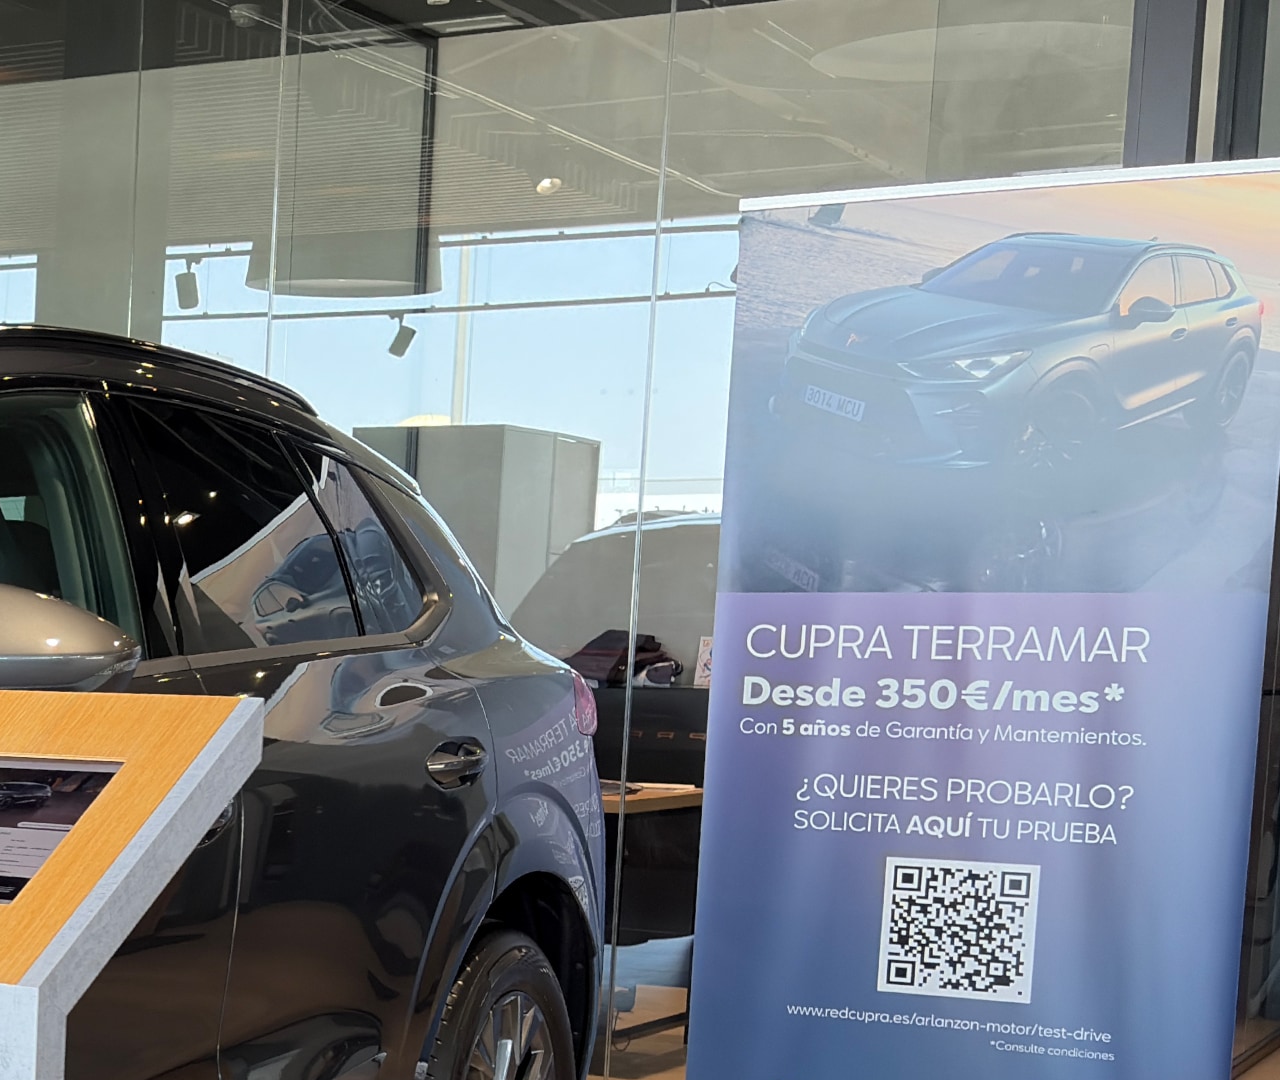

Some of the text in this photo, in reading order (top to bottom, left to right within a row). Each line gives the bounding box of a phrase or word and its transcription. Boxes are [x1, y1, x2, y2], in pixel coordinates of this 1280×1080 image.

[746, 624, 1151, 663] CUPRA TERRAMAR
[742, 676, 866, 708] Desde
[740, 717, 1147, 746] Con 5 años de Garantía y Mantemientos.
[796, 773, 1135, 810] ¿QUIERES PROBARLO?
[794, 809, 1118, 844] SOLICITA AQUÍ TU PRUEBA
[787, 1004, 1112, 1043] www.redcupra.es/arlanzon-motor/test-drive
[1047, 1046, 1115, 1061] condiciones
